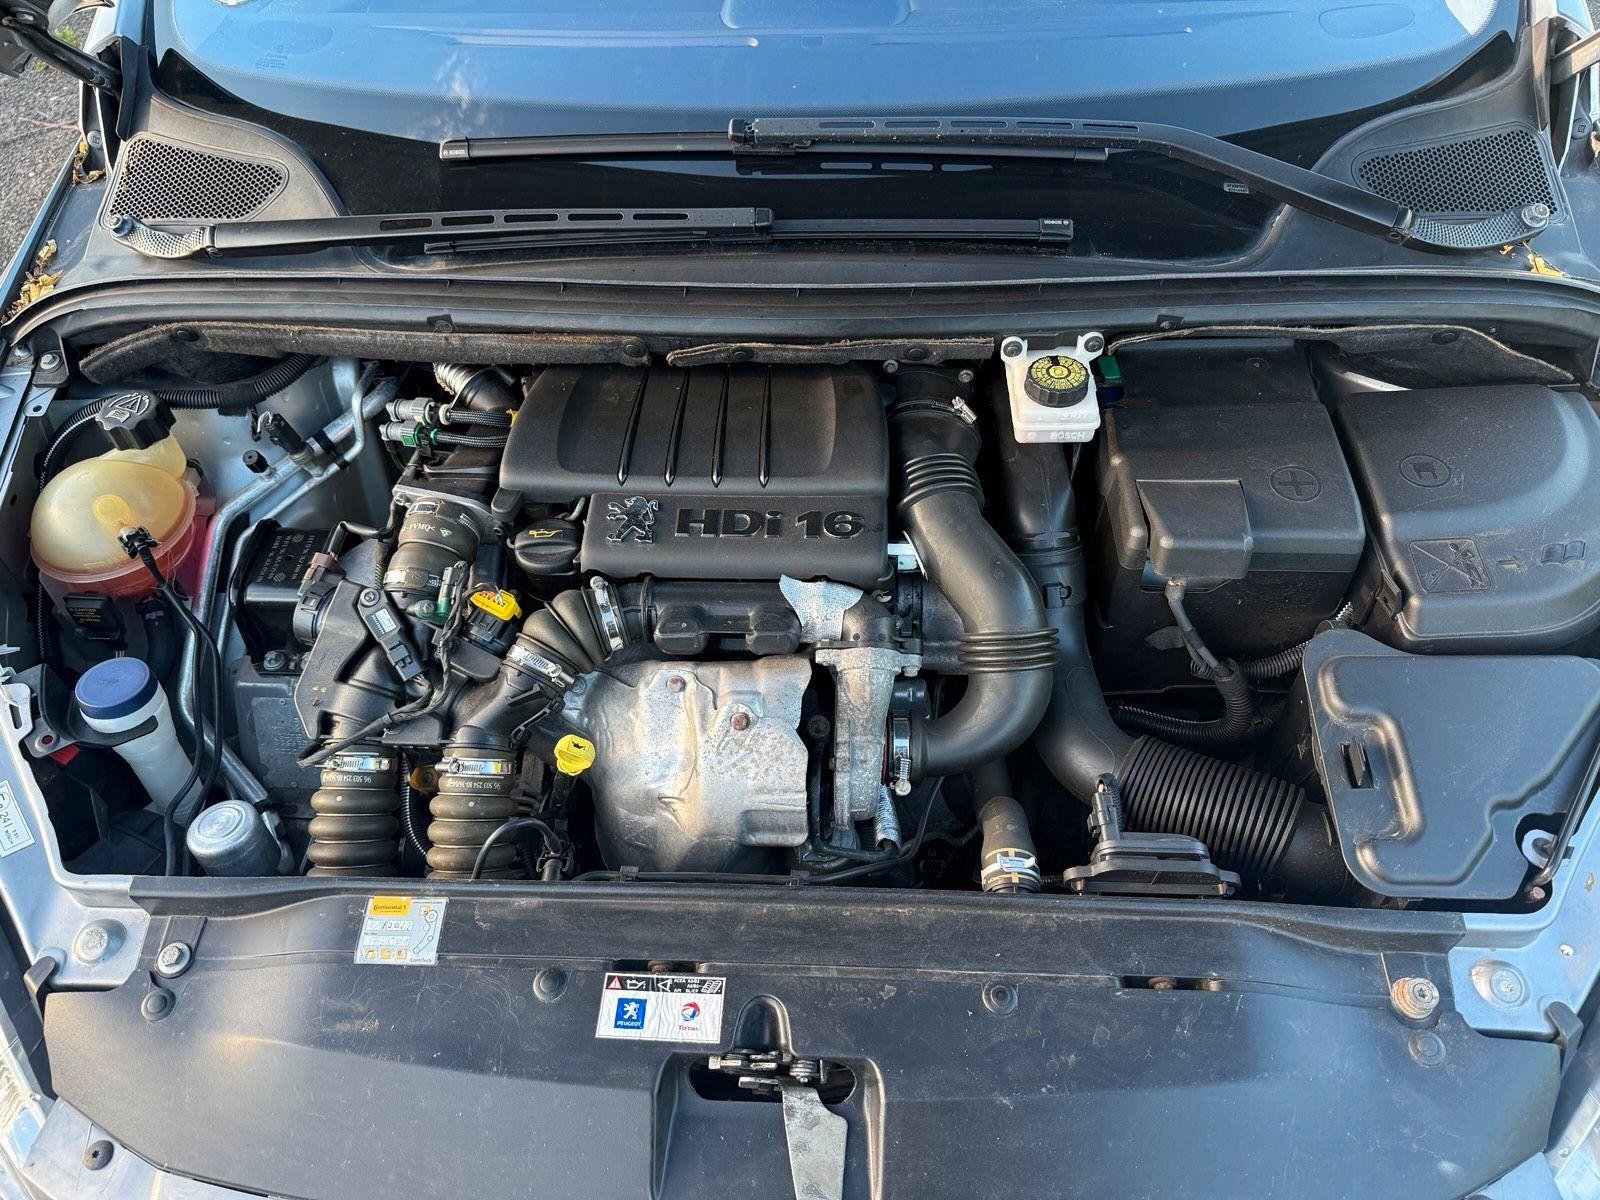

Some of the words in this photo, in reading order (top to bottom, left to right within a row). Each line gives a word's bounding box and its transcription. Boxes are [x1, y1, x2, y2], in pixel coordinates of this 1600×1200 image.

[1050, 431, 1086, 440] BOSCH
[674, 508, 783, 538] HDi
[795, 509, 866, 540] 16
[679, 1024, 700, 1032] TOTAL
